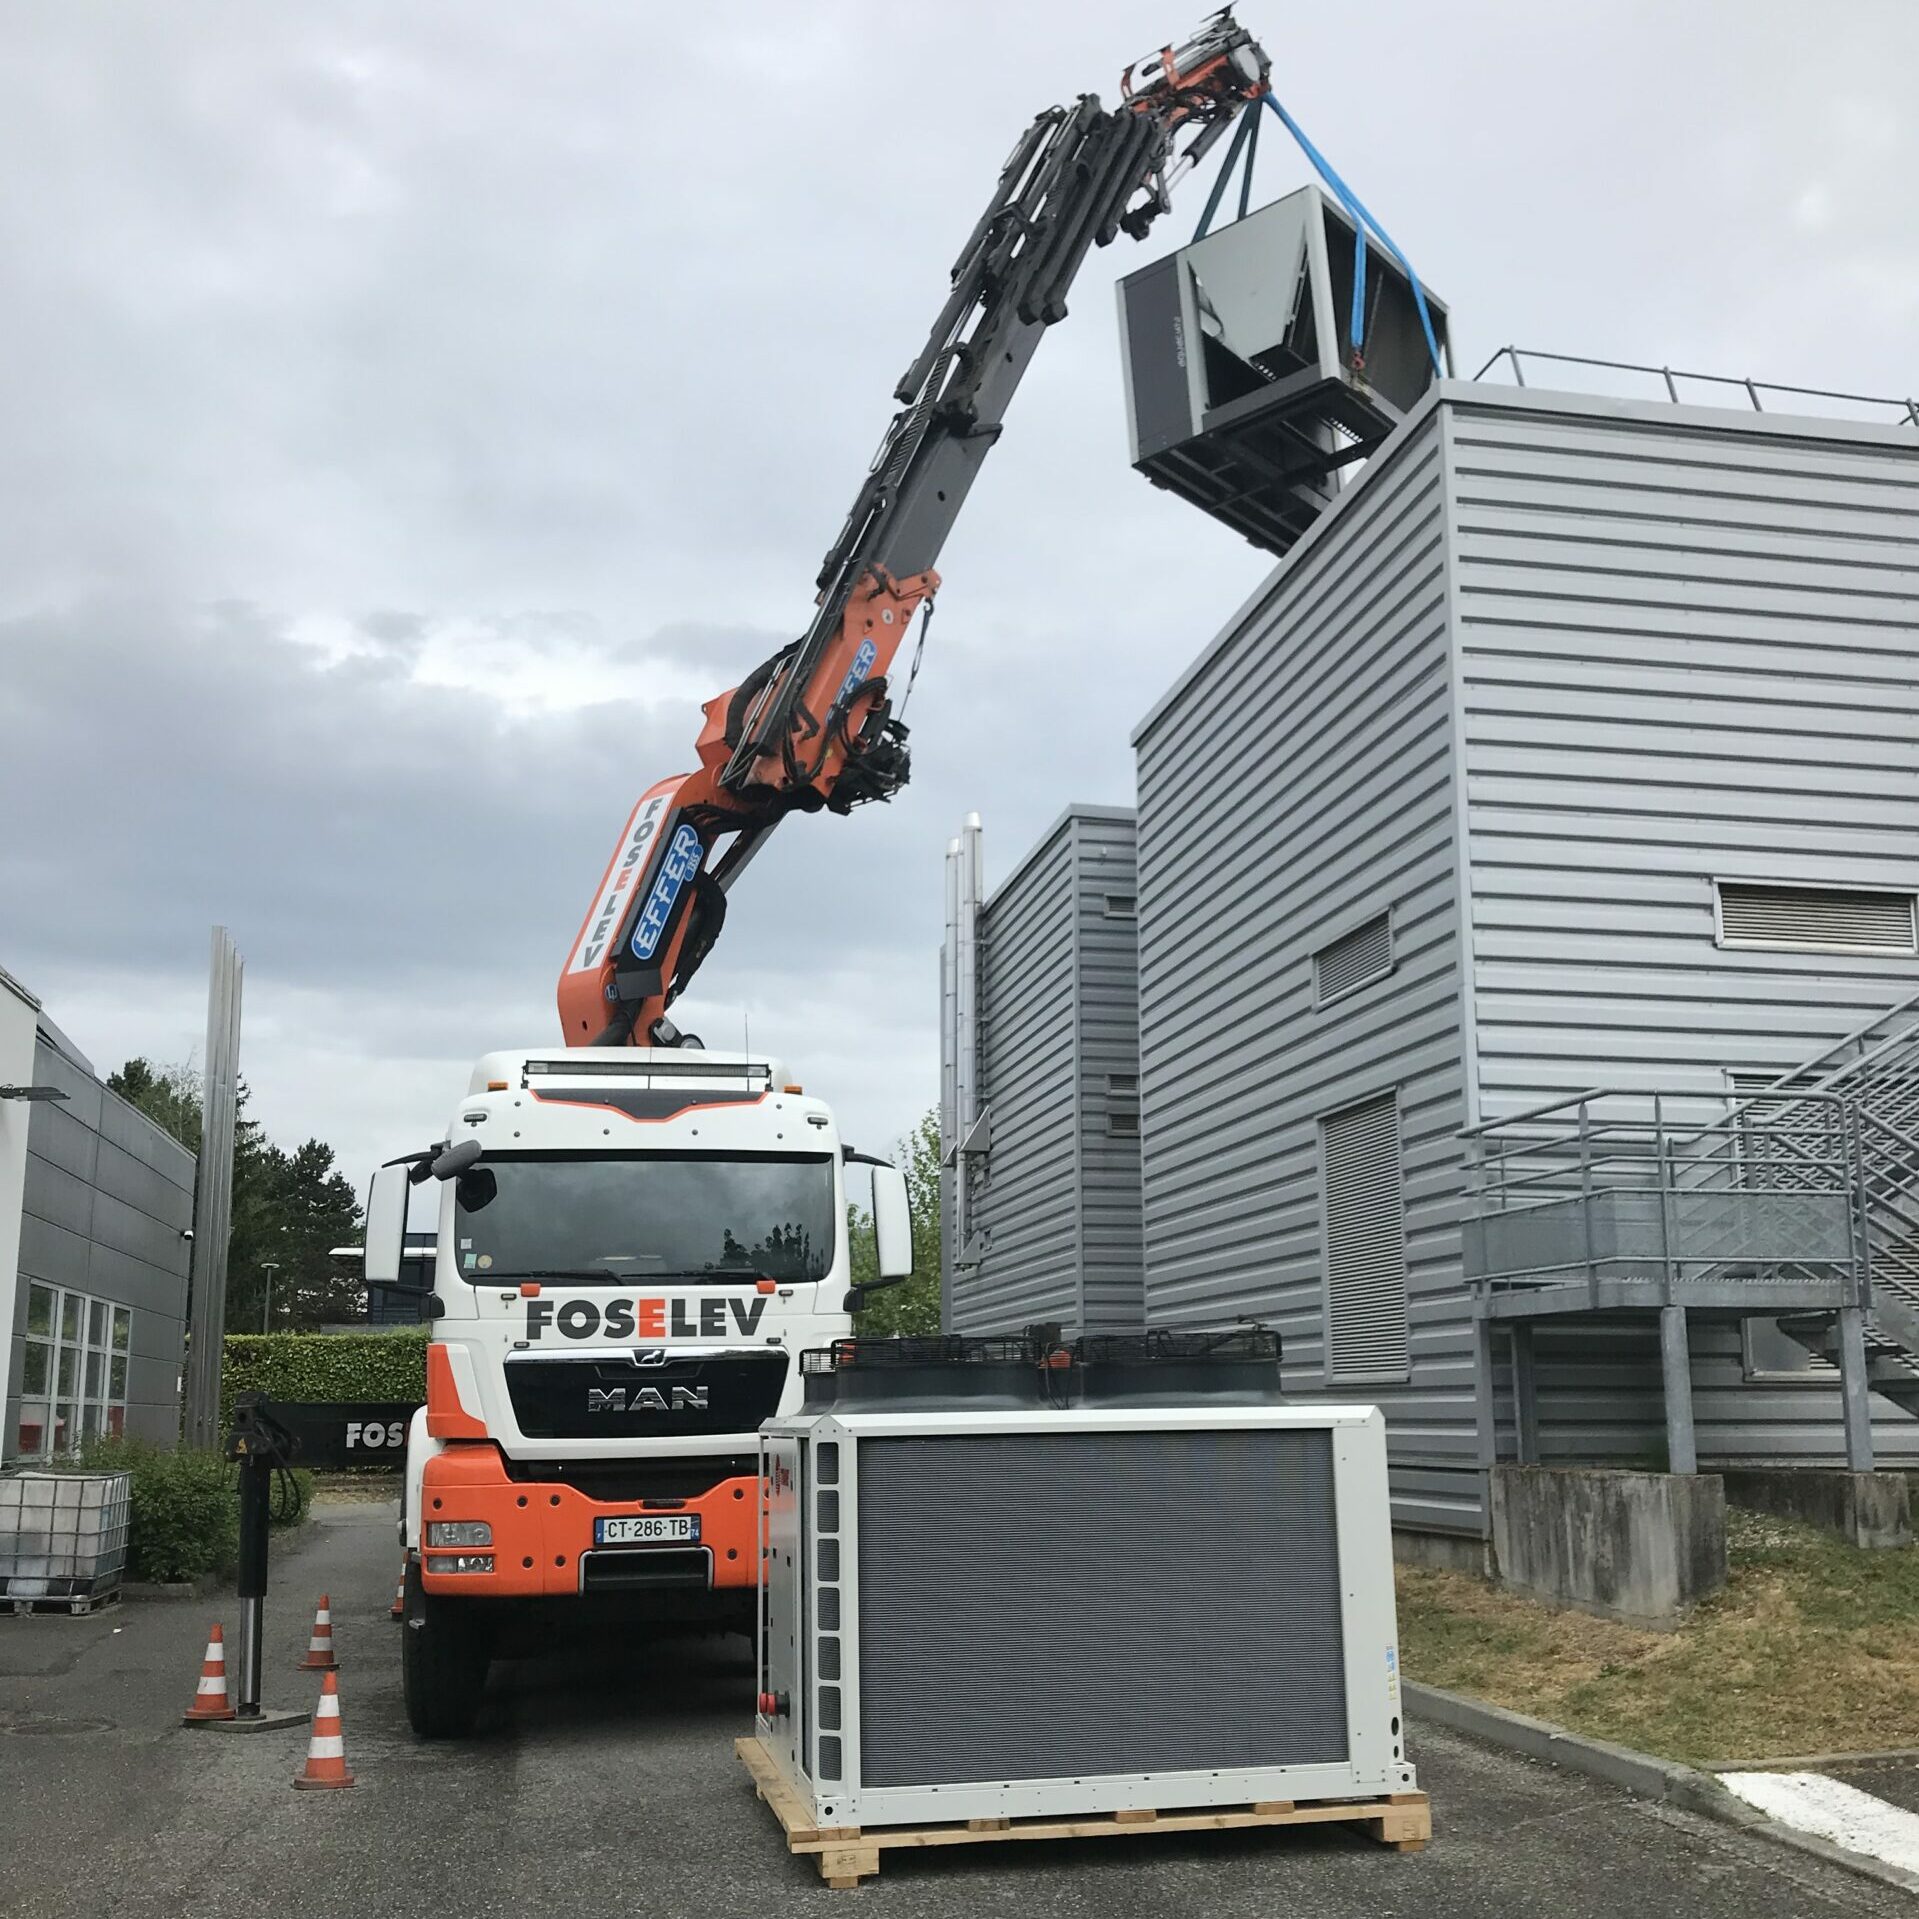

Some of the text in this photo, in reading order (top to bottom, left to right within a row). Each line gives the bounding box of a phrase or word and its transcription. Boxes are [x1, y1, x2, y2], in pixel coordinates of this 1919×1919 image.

[583, 798, 662, 967] FOSELEV
[636, 830, 696, 950] EFFER
[526, 1298, 768, 1340] FOSELEV
[588, 1386, 709, 1411] MAN
[346, 1422, 410, 1448] FOS
[608, 1519, 689, 1538] CT-286-TB
